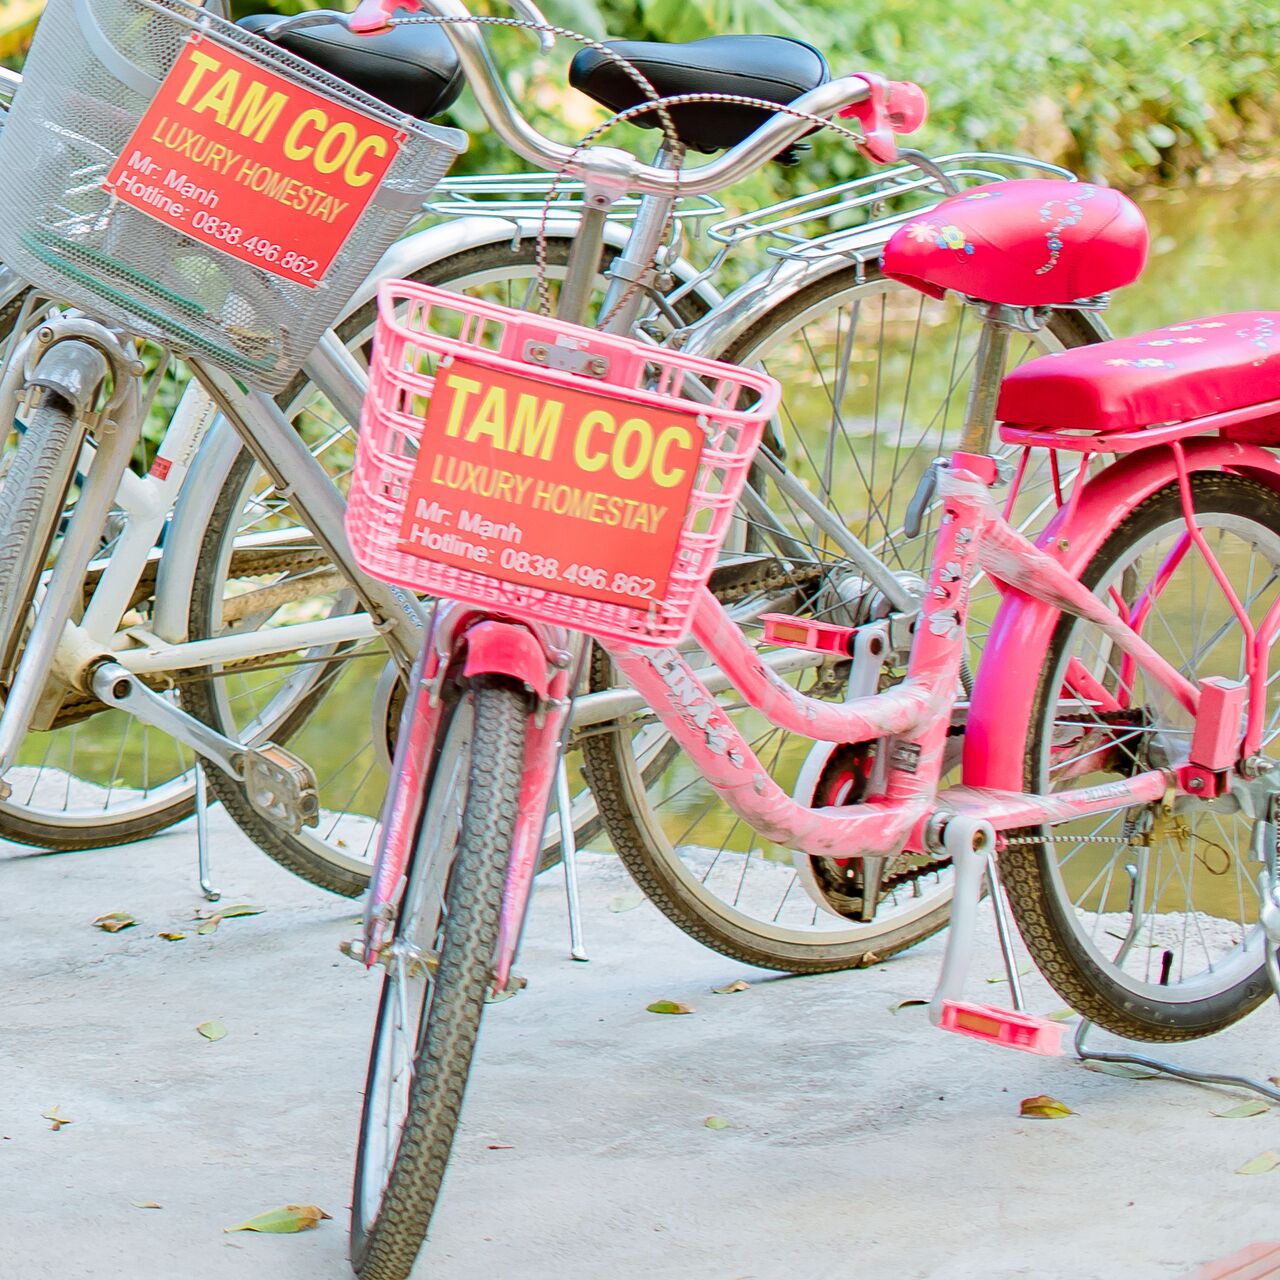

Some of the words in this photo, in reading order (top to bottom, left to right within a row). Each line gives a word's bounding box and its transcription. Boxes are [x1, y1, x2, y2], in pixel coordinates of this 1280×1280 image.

[176, 50, 288, 143] TAM
[284, 109, 387, 186] COC
[152, 117, 241, 174] LUXURY
[235, 159, 348, 223] HOMESTAY
[163, 170, 218, 208] Mạnh
[116, 173, 190, 220] Hotline:
[192, 211, 318, 280] 0838.496.862
[446, 375, 564, 460] TAM
[574, 410, 691, 487] COC
[432, 455, 533, 504] LUXURY
[534, 481, 667, 532] HOMESTAY
[458, 510, 522, 543] Mạnh
[410, 524, 494, 564] Hotline:
[501, 548, 655, 599] 0838.496.862
